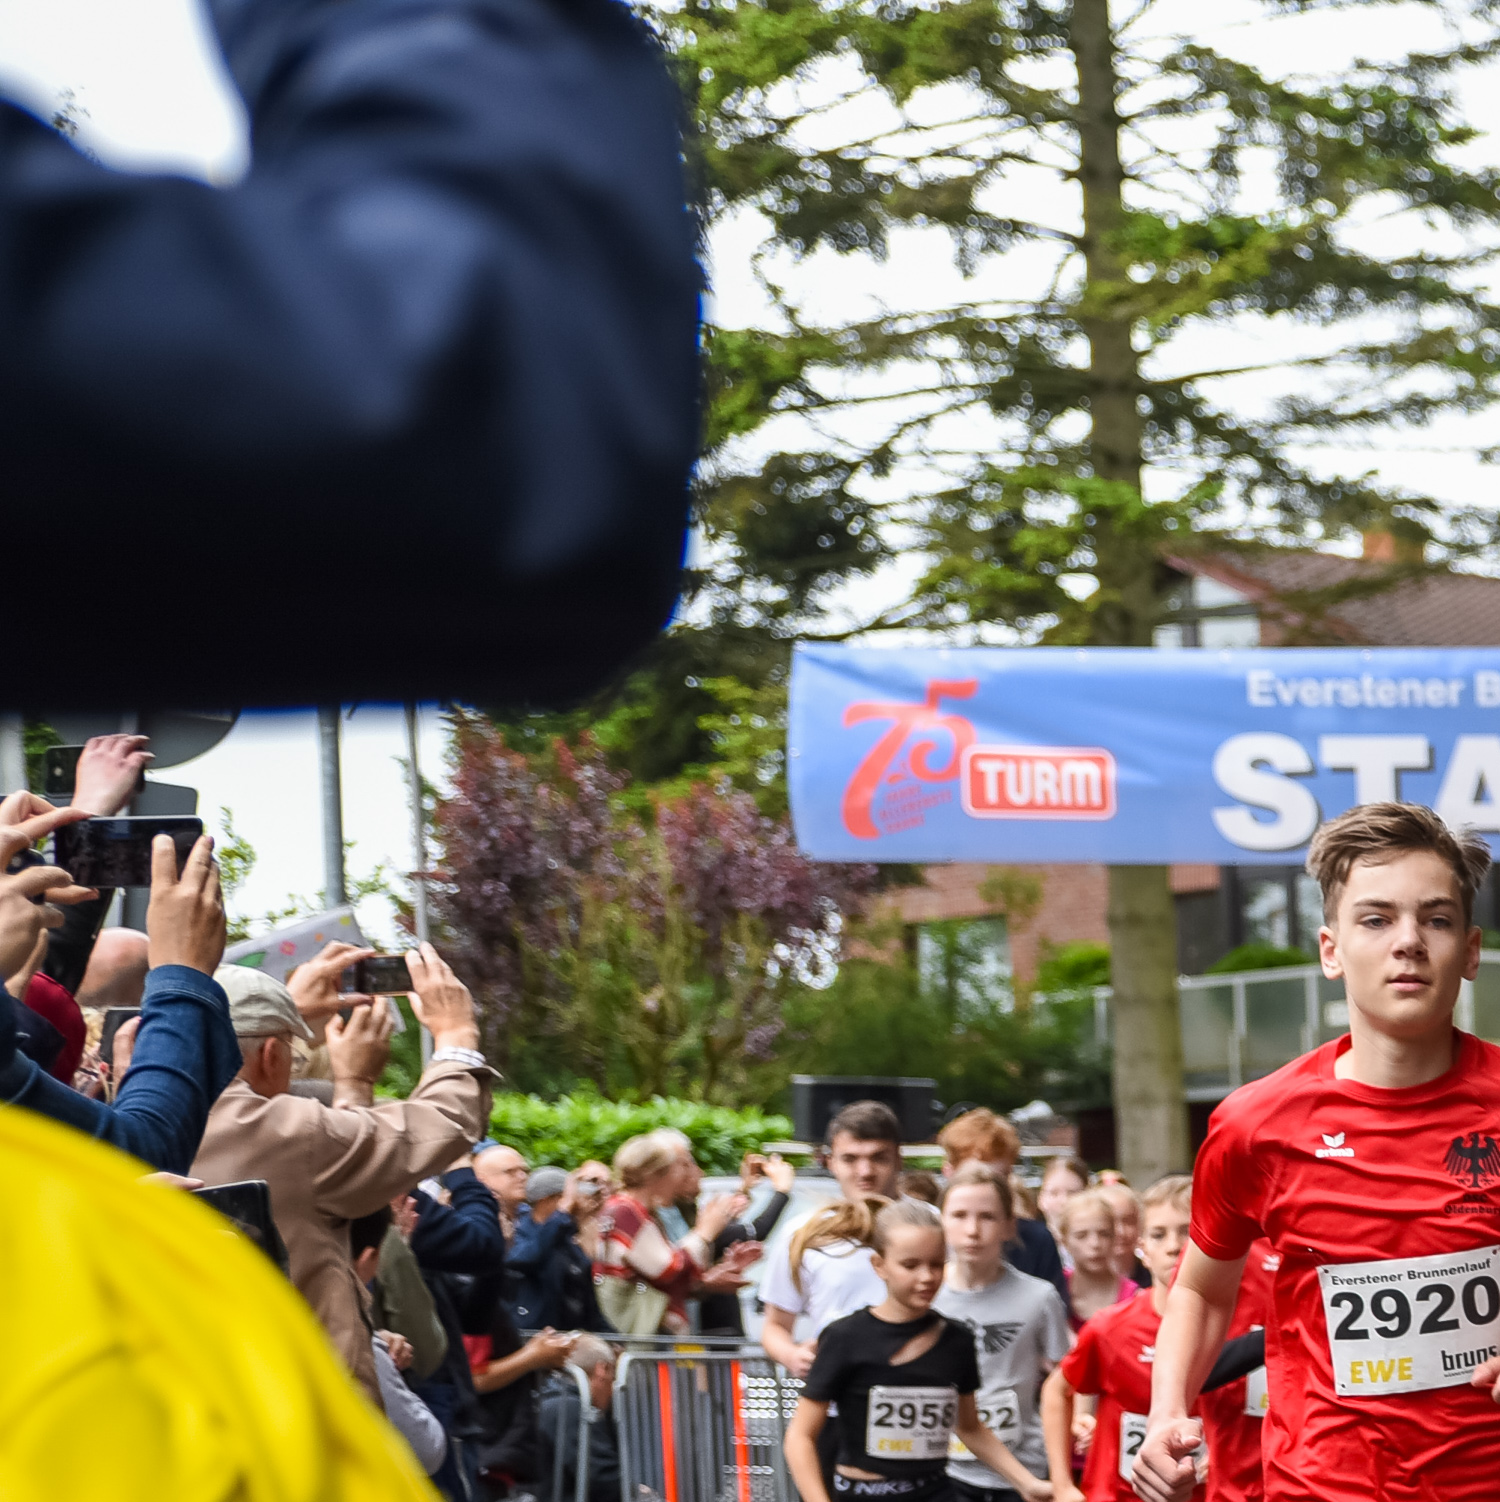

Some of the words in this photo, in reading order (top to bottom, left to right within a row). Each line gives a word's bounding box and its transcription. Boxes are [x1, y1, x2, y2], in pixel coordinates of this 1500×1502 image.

[1247, 670, 1464, 708] Everstener
[842, 679, 978, 839] 75
[976, 759, 1101, 806] TURM
[1331, 1273, 1403, 1286] Everstener
[1407, 1258, 1491, 1280] Brunnenlauf
[1330, 1275, 1500, 1340] 2920
[1350, 1357, 1413, 1384] EWE
[1441, 1345, 1498, 1371] bruns
[873, 1402, 957, 1430] 2958
[853, 1479, 915, 1496] NIKE
